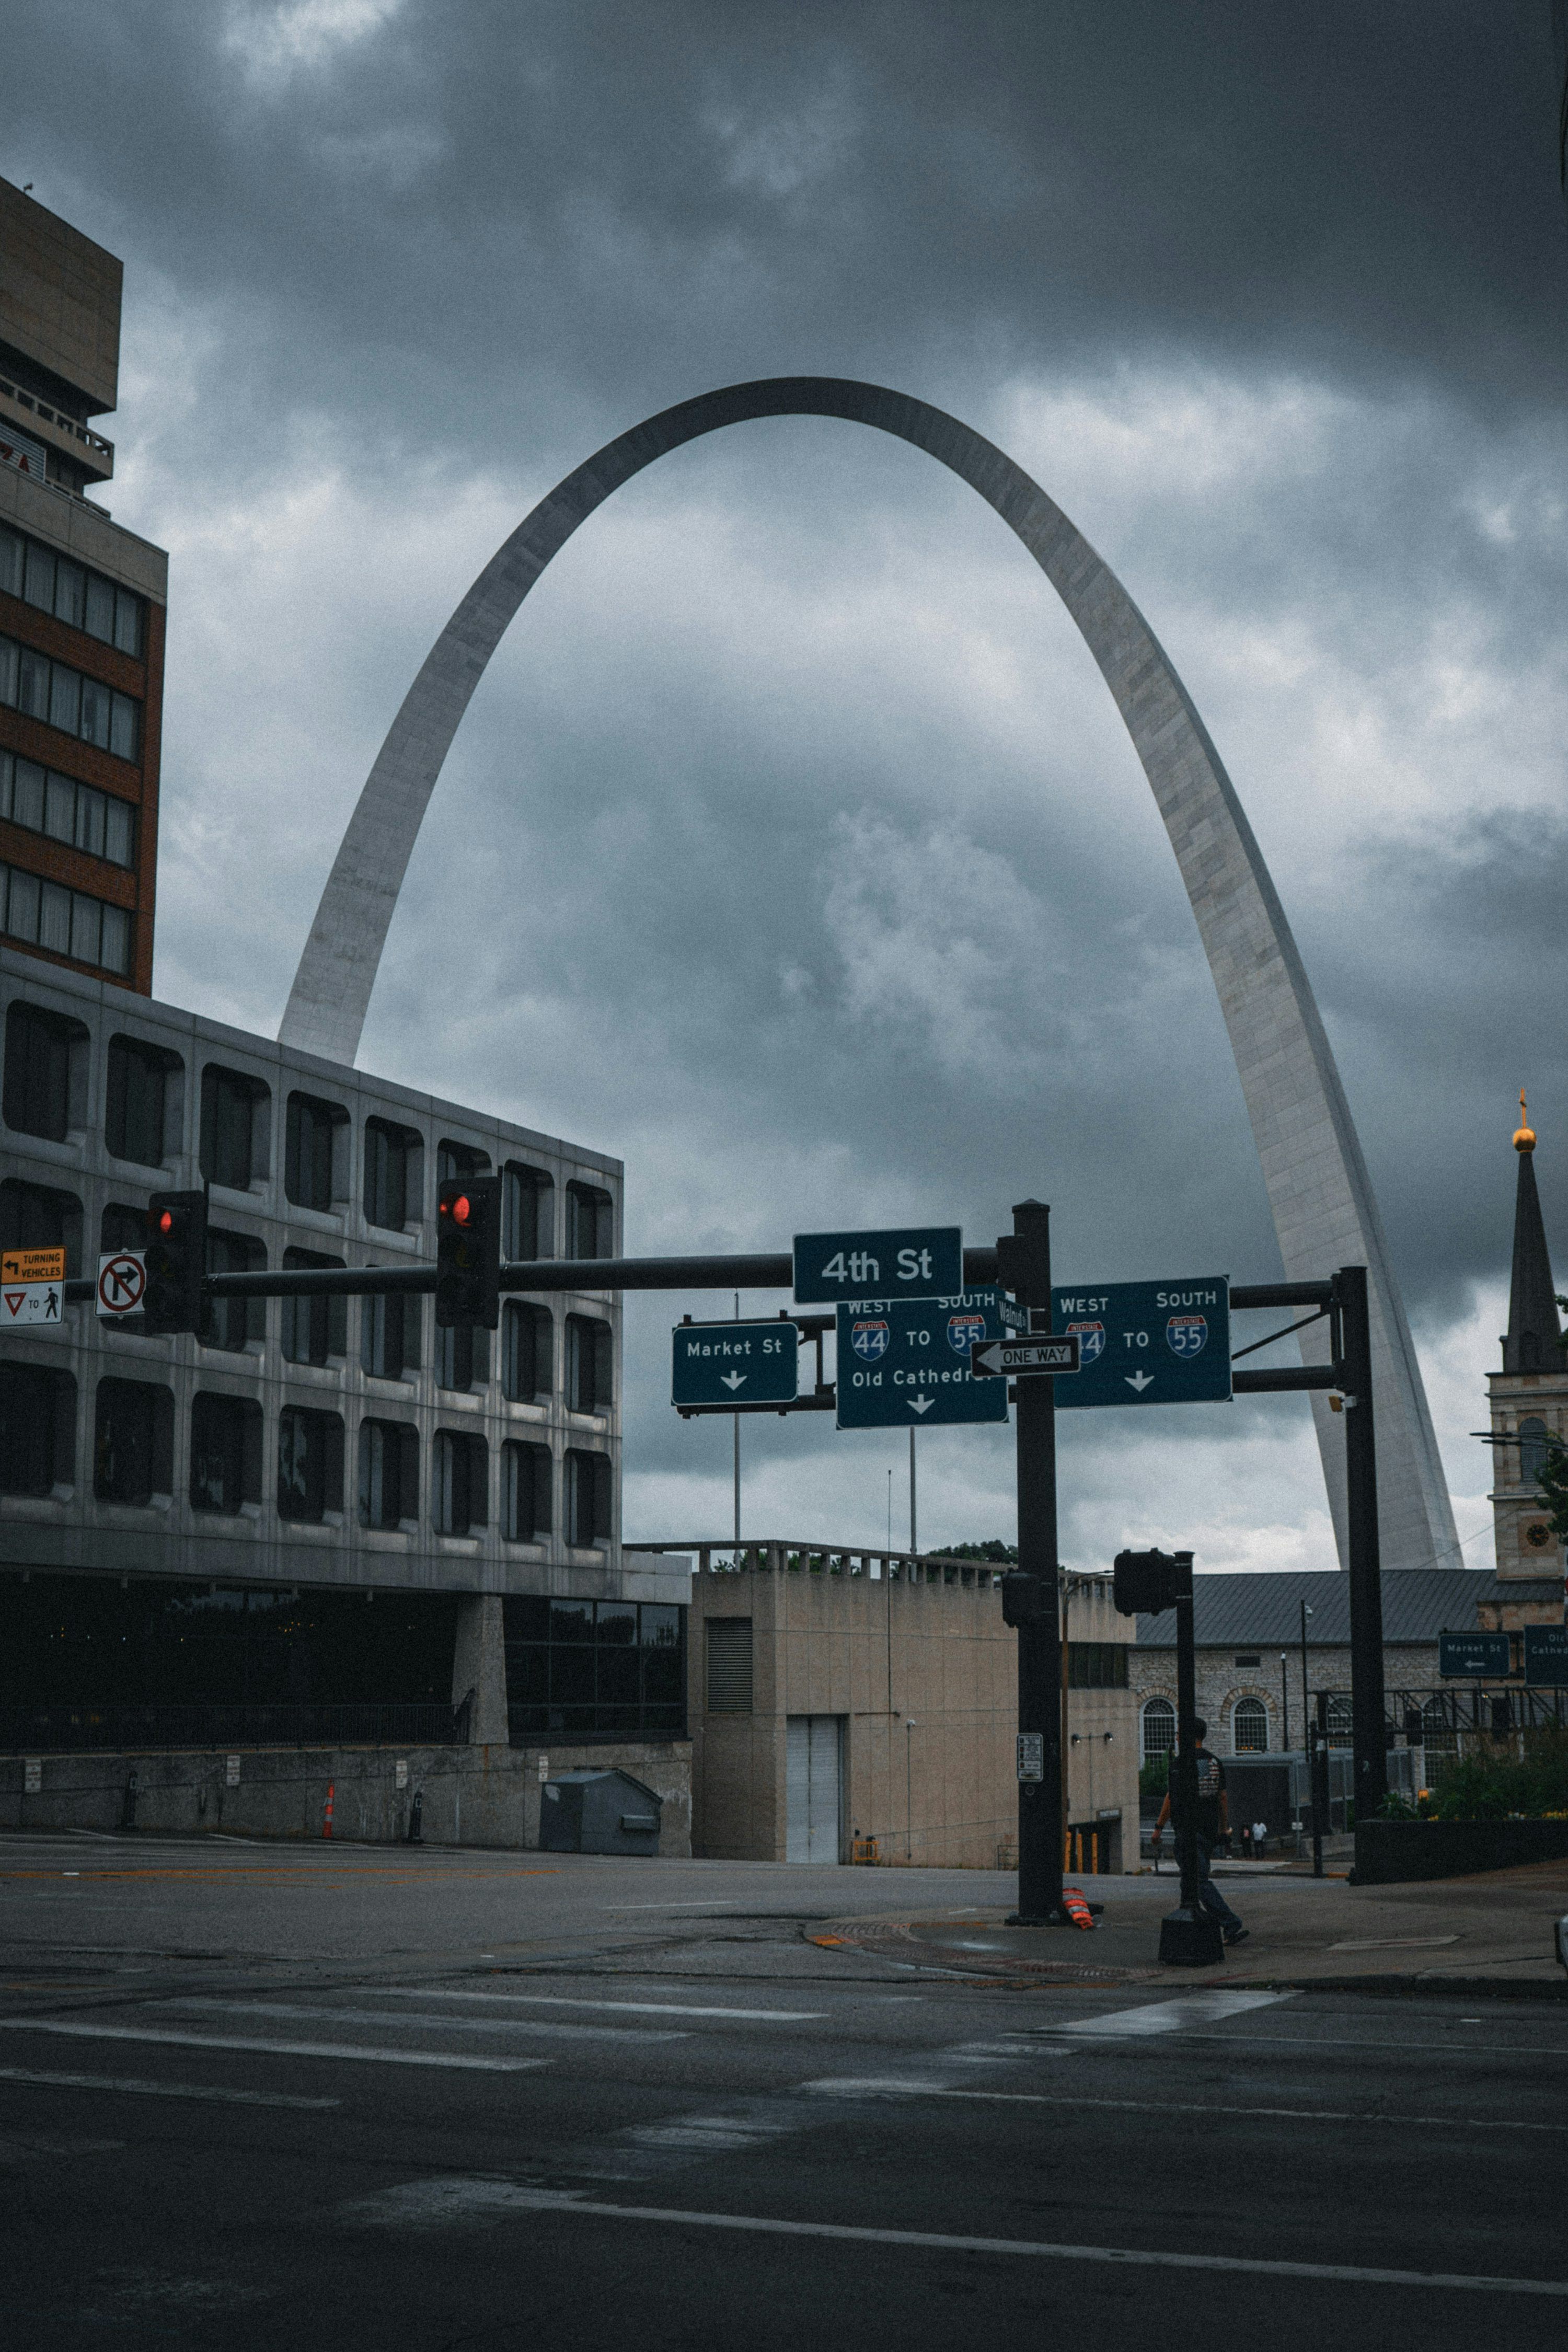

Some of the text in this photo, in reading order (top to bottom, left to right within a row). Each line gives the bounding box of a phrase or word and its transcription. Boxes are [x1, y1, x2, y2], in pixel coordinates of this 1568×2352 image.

[24, 1253, 60, 1264] TURNING
[821, 1248, 933, 1283] 4th St
[22, 1267, 61, 1277] VEHICLES
[29, 1300, 39, 1309] TO
[938, 1293, 995, 1309] SOUTH
[1060, 1291, 1217, 1313] WEST SOUTH
[999, 1300, 1022, 1328] Walnut
[687, 1338, 781, 1356] Market St
[854, 1325, 980, 1353] 44 TO 55
[1123, 1331, 1149, 1348] TO
[1174, 1326, 1202, 1350] 55
[1003, 1347, 1066, 1364] ONE WAY
[852, 1367, 991, 1387] Old Cathedr
[1447, 1644, 1501, 1652] Market St
